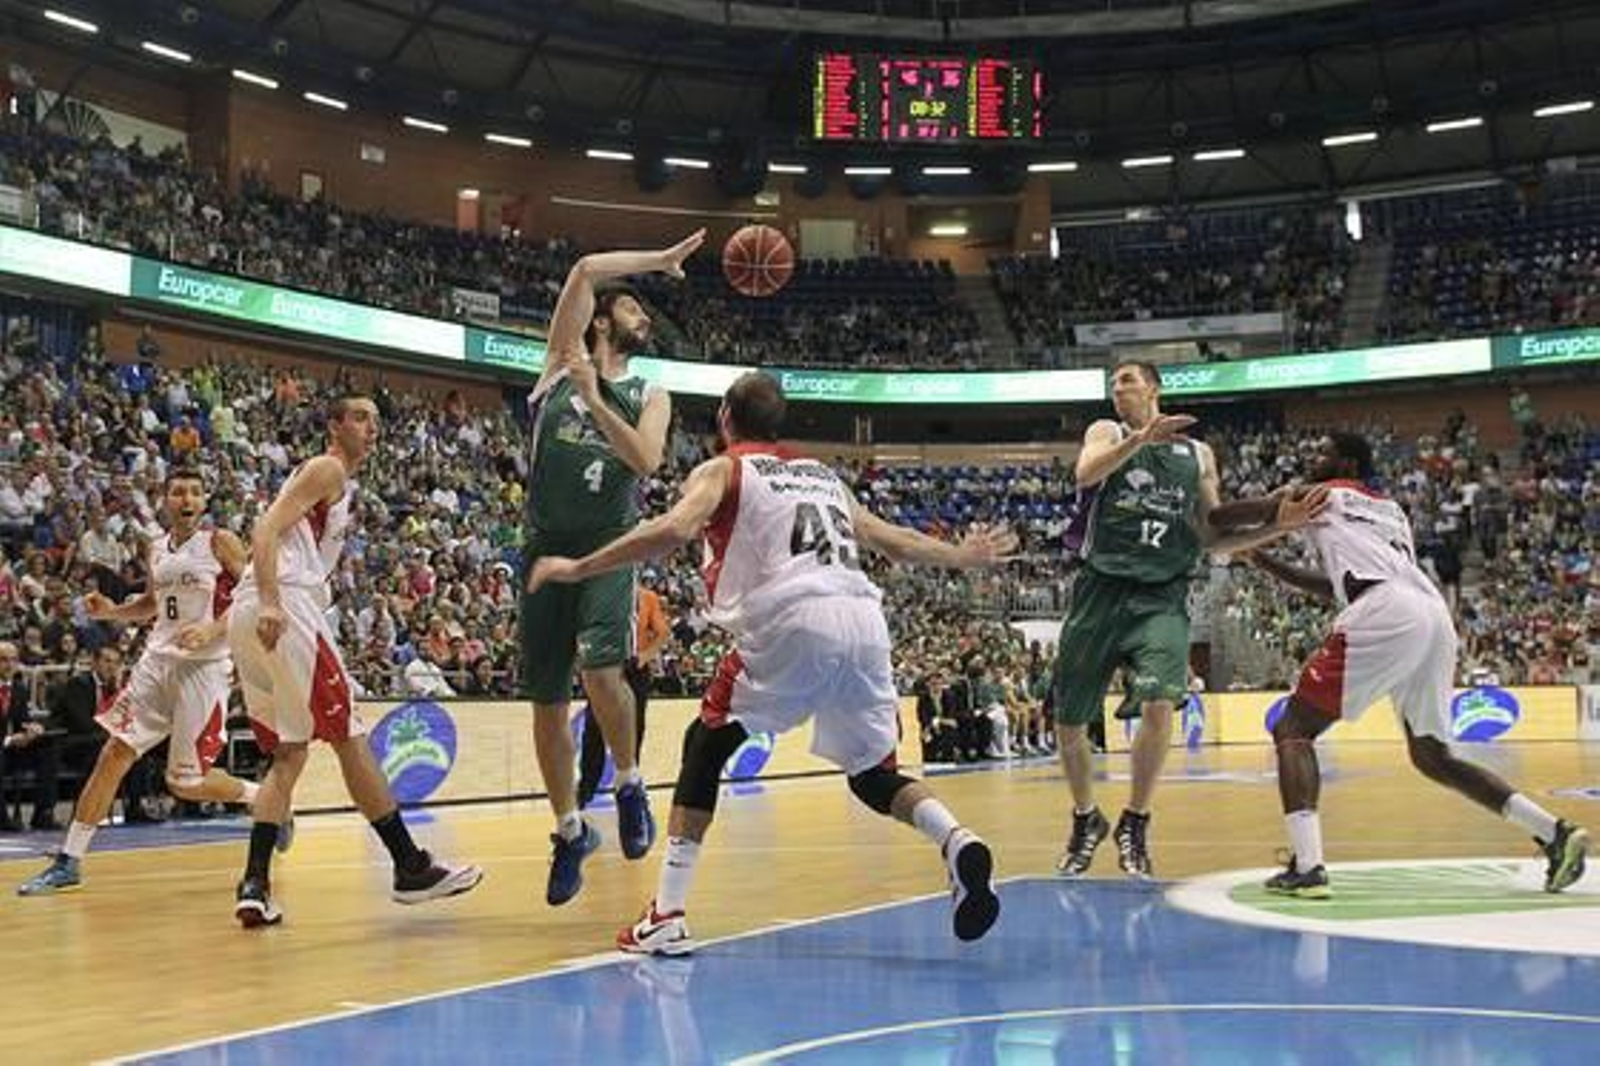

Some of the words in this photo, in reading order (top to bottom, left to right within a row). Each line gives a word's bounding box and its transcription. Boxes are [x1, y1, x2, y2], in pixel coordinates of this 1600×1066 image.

[159, 266, 244, 307] Europcar
[484, 334, 548, 361] Europca
[1521, 336, 1600, 358] Europc
[781, 373, 859, 397] Europcar
[1161, 369, 1217, 388] opcar
[583, 460, 604, 493] 4
[1140, 520, 1169, 548] 17
